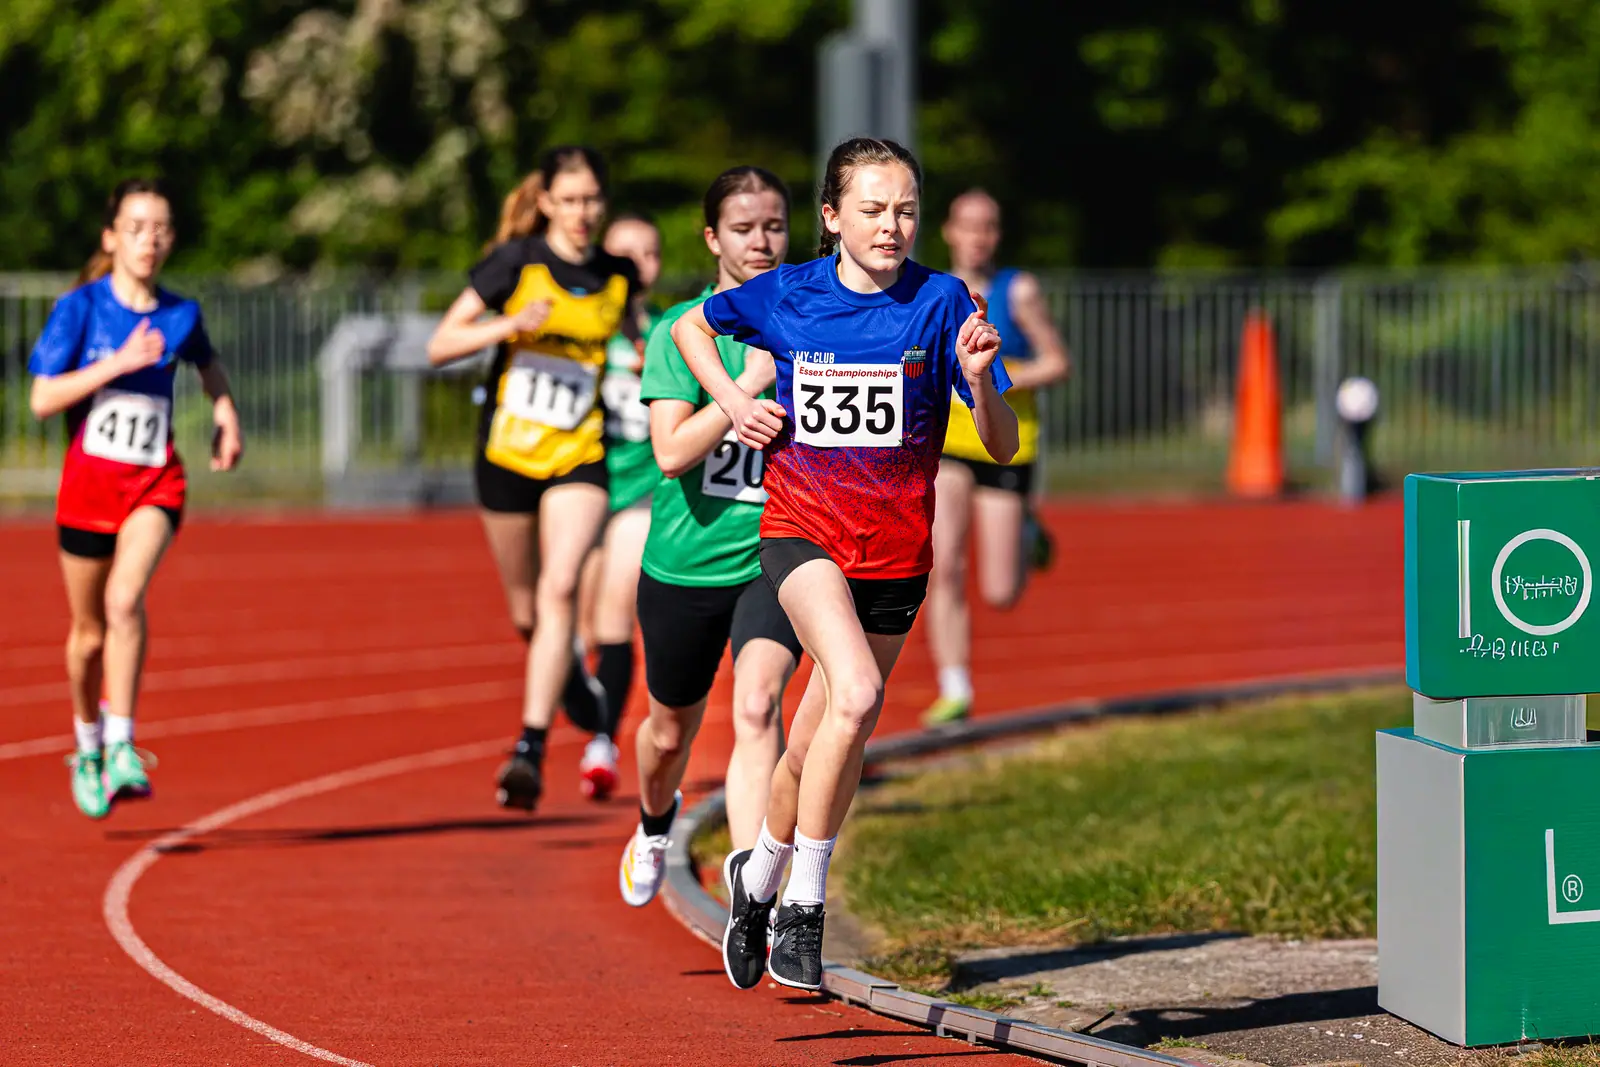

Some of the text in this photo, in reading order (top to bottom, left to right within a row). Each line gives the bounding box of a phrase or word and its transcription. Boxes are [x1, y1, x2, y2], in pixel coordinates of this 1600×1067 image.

[799, 366, 898, 379] Essex Championships
[800, 383, 895, 434] 335
[98, 409, 160, 453] 412
